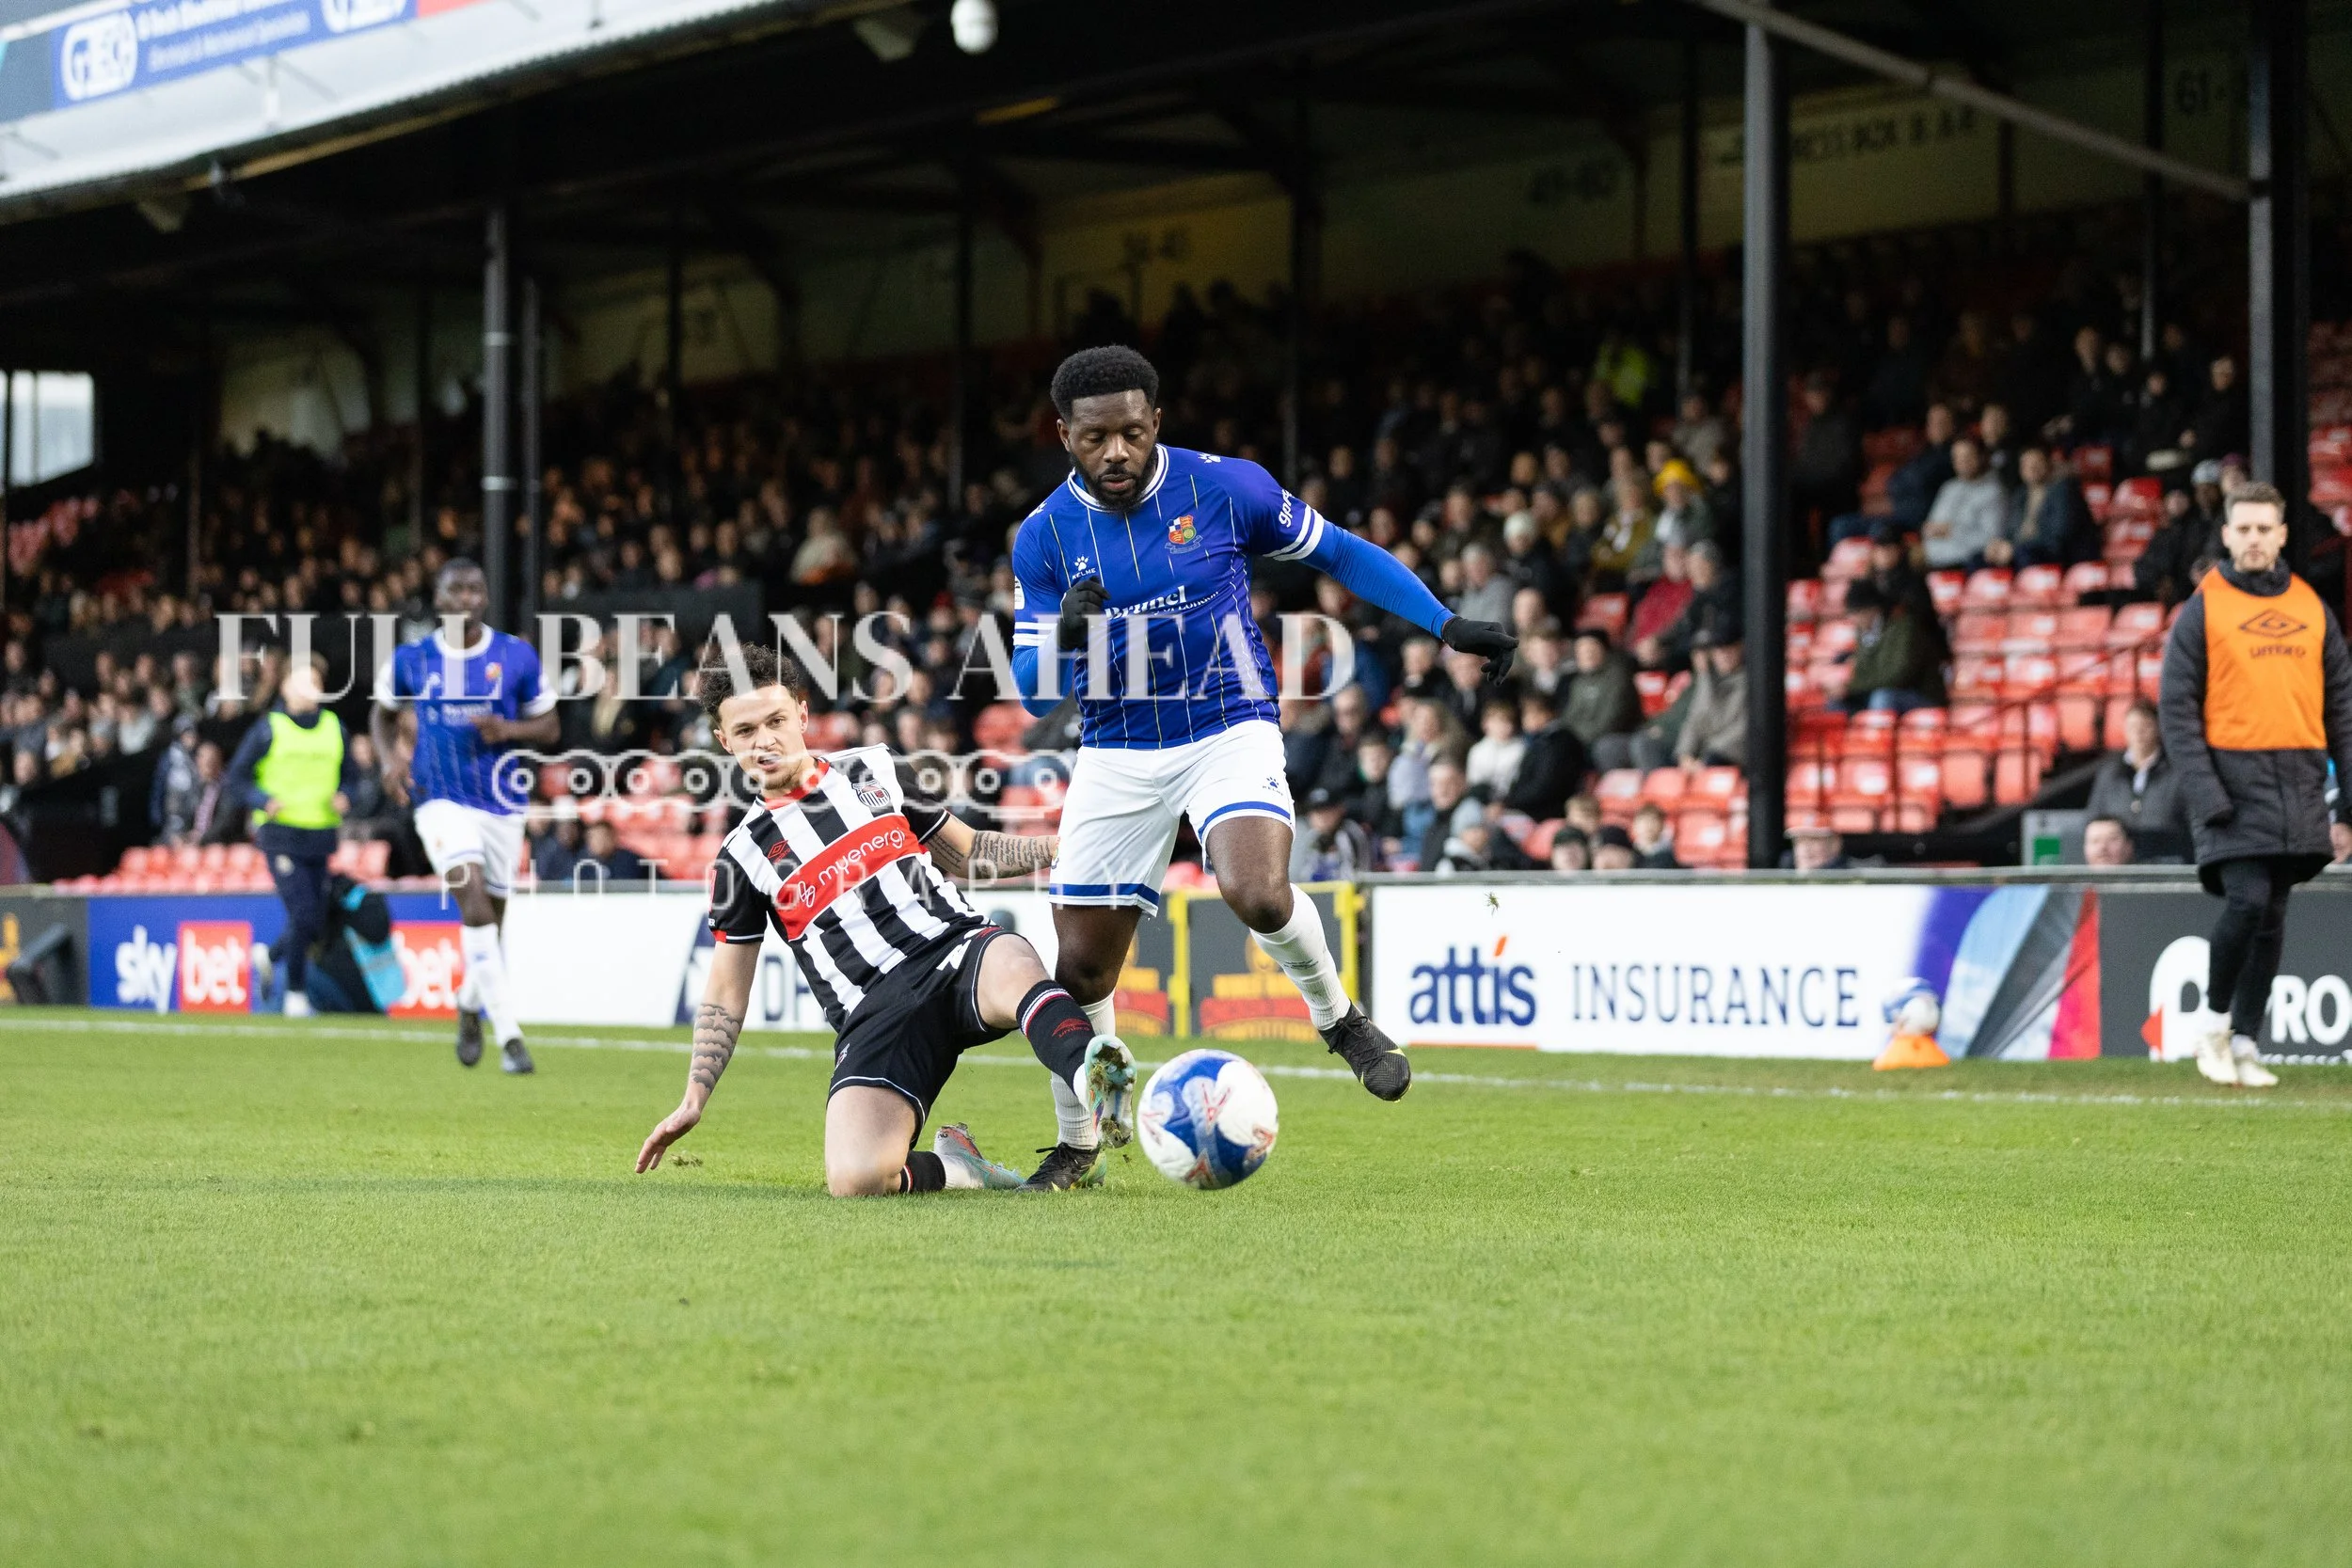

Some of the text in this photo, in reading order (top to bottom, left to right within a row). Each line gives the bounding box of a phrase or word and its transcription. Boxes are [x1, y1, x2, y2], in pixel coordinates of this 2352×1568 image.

[1072, 567, 1096, 580] KELME
[1104, 585, 1186, 620] Brunel
[818, 826, 905, 886] myenergi
[116, 925, 246, 1013] sky bet
[1409, 936, 1860, 1027] attis INSURANCE
